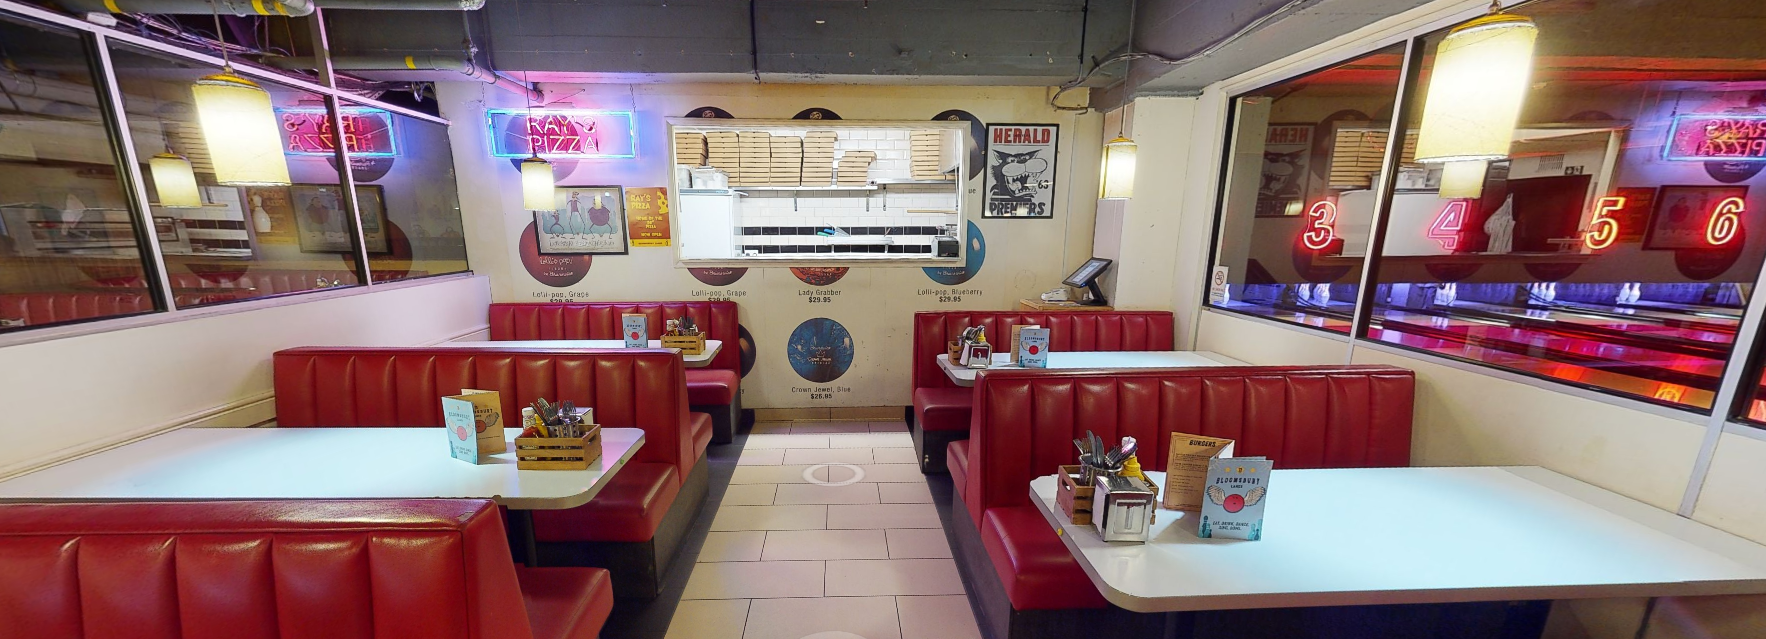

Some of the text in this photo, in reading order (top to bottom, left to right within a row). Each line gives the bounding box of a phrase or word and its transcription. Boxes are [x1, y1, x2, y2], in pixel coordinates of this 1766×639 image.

[526, 114, 597, 133] RAY'S
[993, 127, 1051, 144] HERALD
[528, 135, 599, 154] PIZZA
[630, 194, 651, 202] RAY'S
[1303, 200, 1337, 249] 3
[1428, 201, 1467, 250] 4
[1585, 196, 1626, 250] 5
[1706, 196, 1745, 246] 6
[569, 290, 590, 298] Grape
[917, 288, 983, 297] Lolli-pop, Blueberry
[814, 386, 835, 394] Jewel,
[1189, 439, 1216, 447] BURGERS
[1215, 477, 1260, 486] BLOOMSBURY
